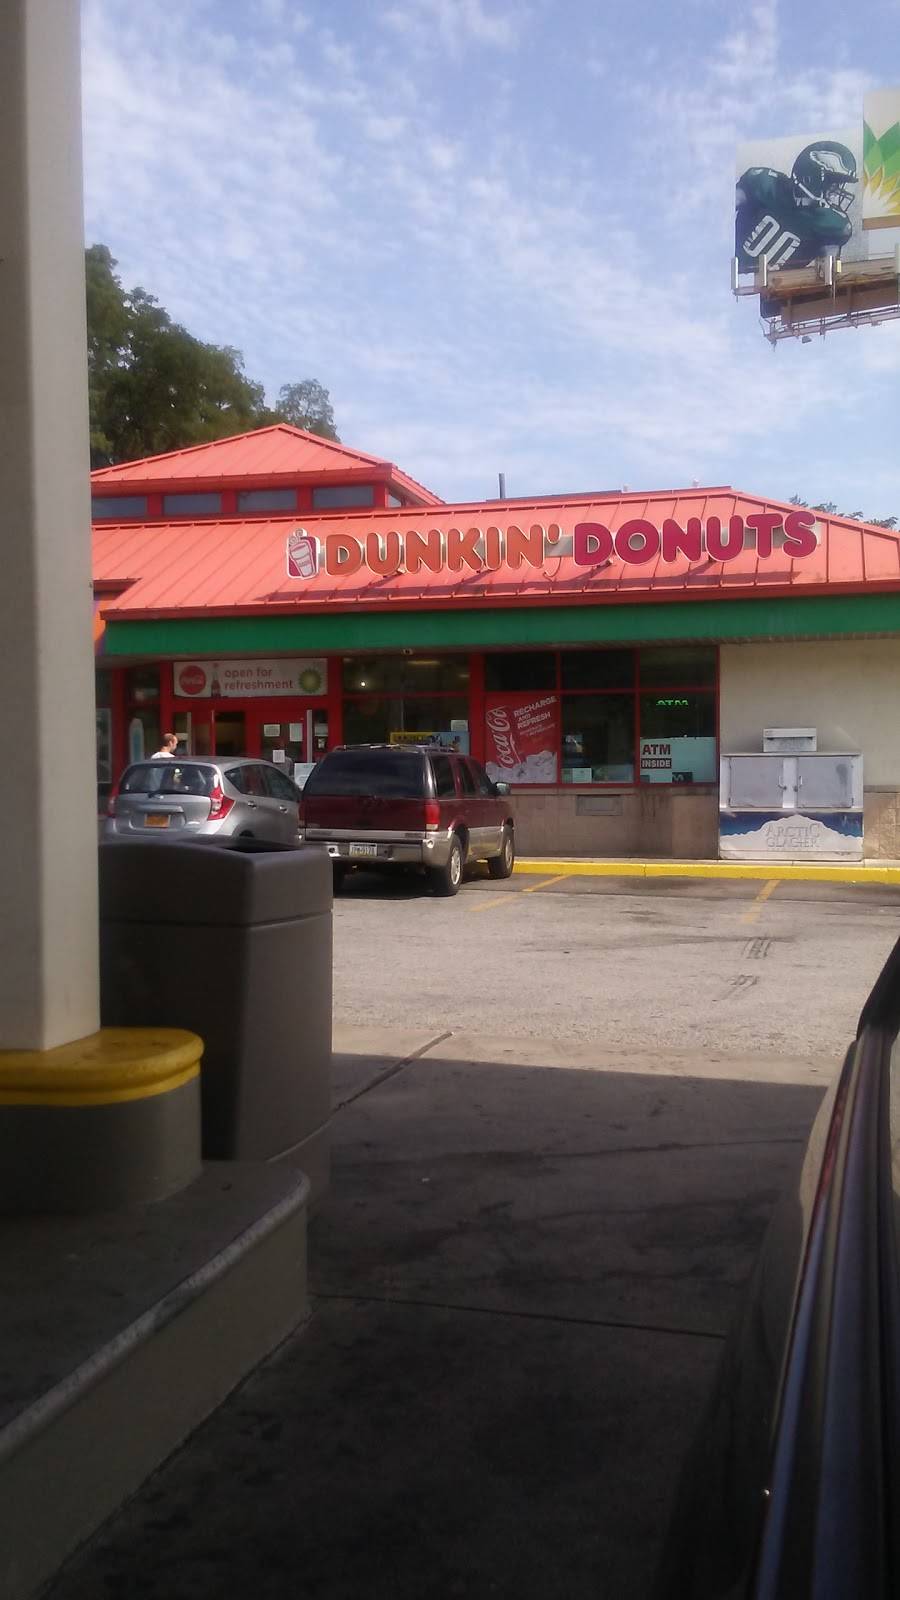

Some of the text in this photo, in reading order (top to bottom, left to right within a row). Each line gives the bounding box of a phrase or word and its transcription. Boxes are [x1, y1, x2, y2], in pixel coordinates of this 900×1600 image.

[325, 511, 818, 577] DUNKIN' DONUTS
[224, 667, 273, 679] open for
[224, 679, 294, 690] refreshment
[514, 696, 558, 717] RECHARGE
[517, 711, 551, 730] REFRESH
[642, 744, 671, 755] ATM
[641, 759, 671, 768] INSIDE
